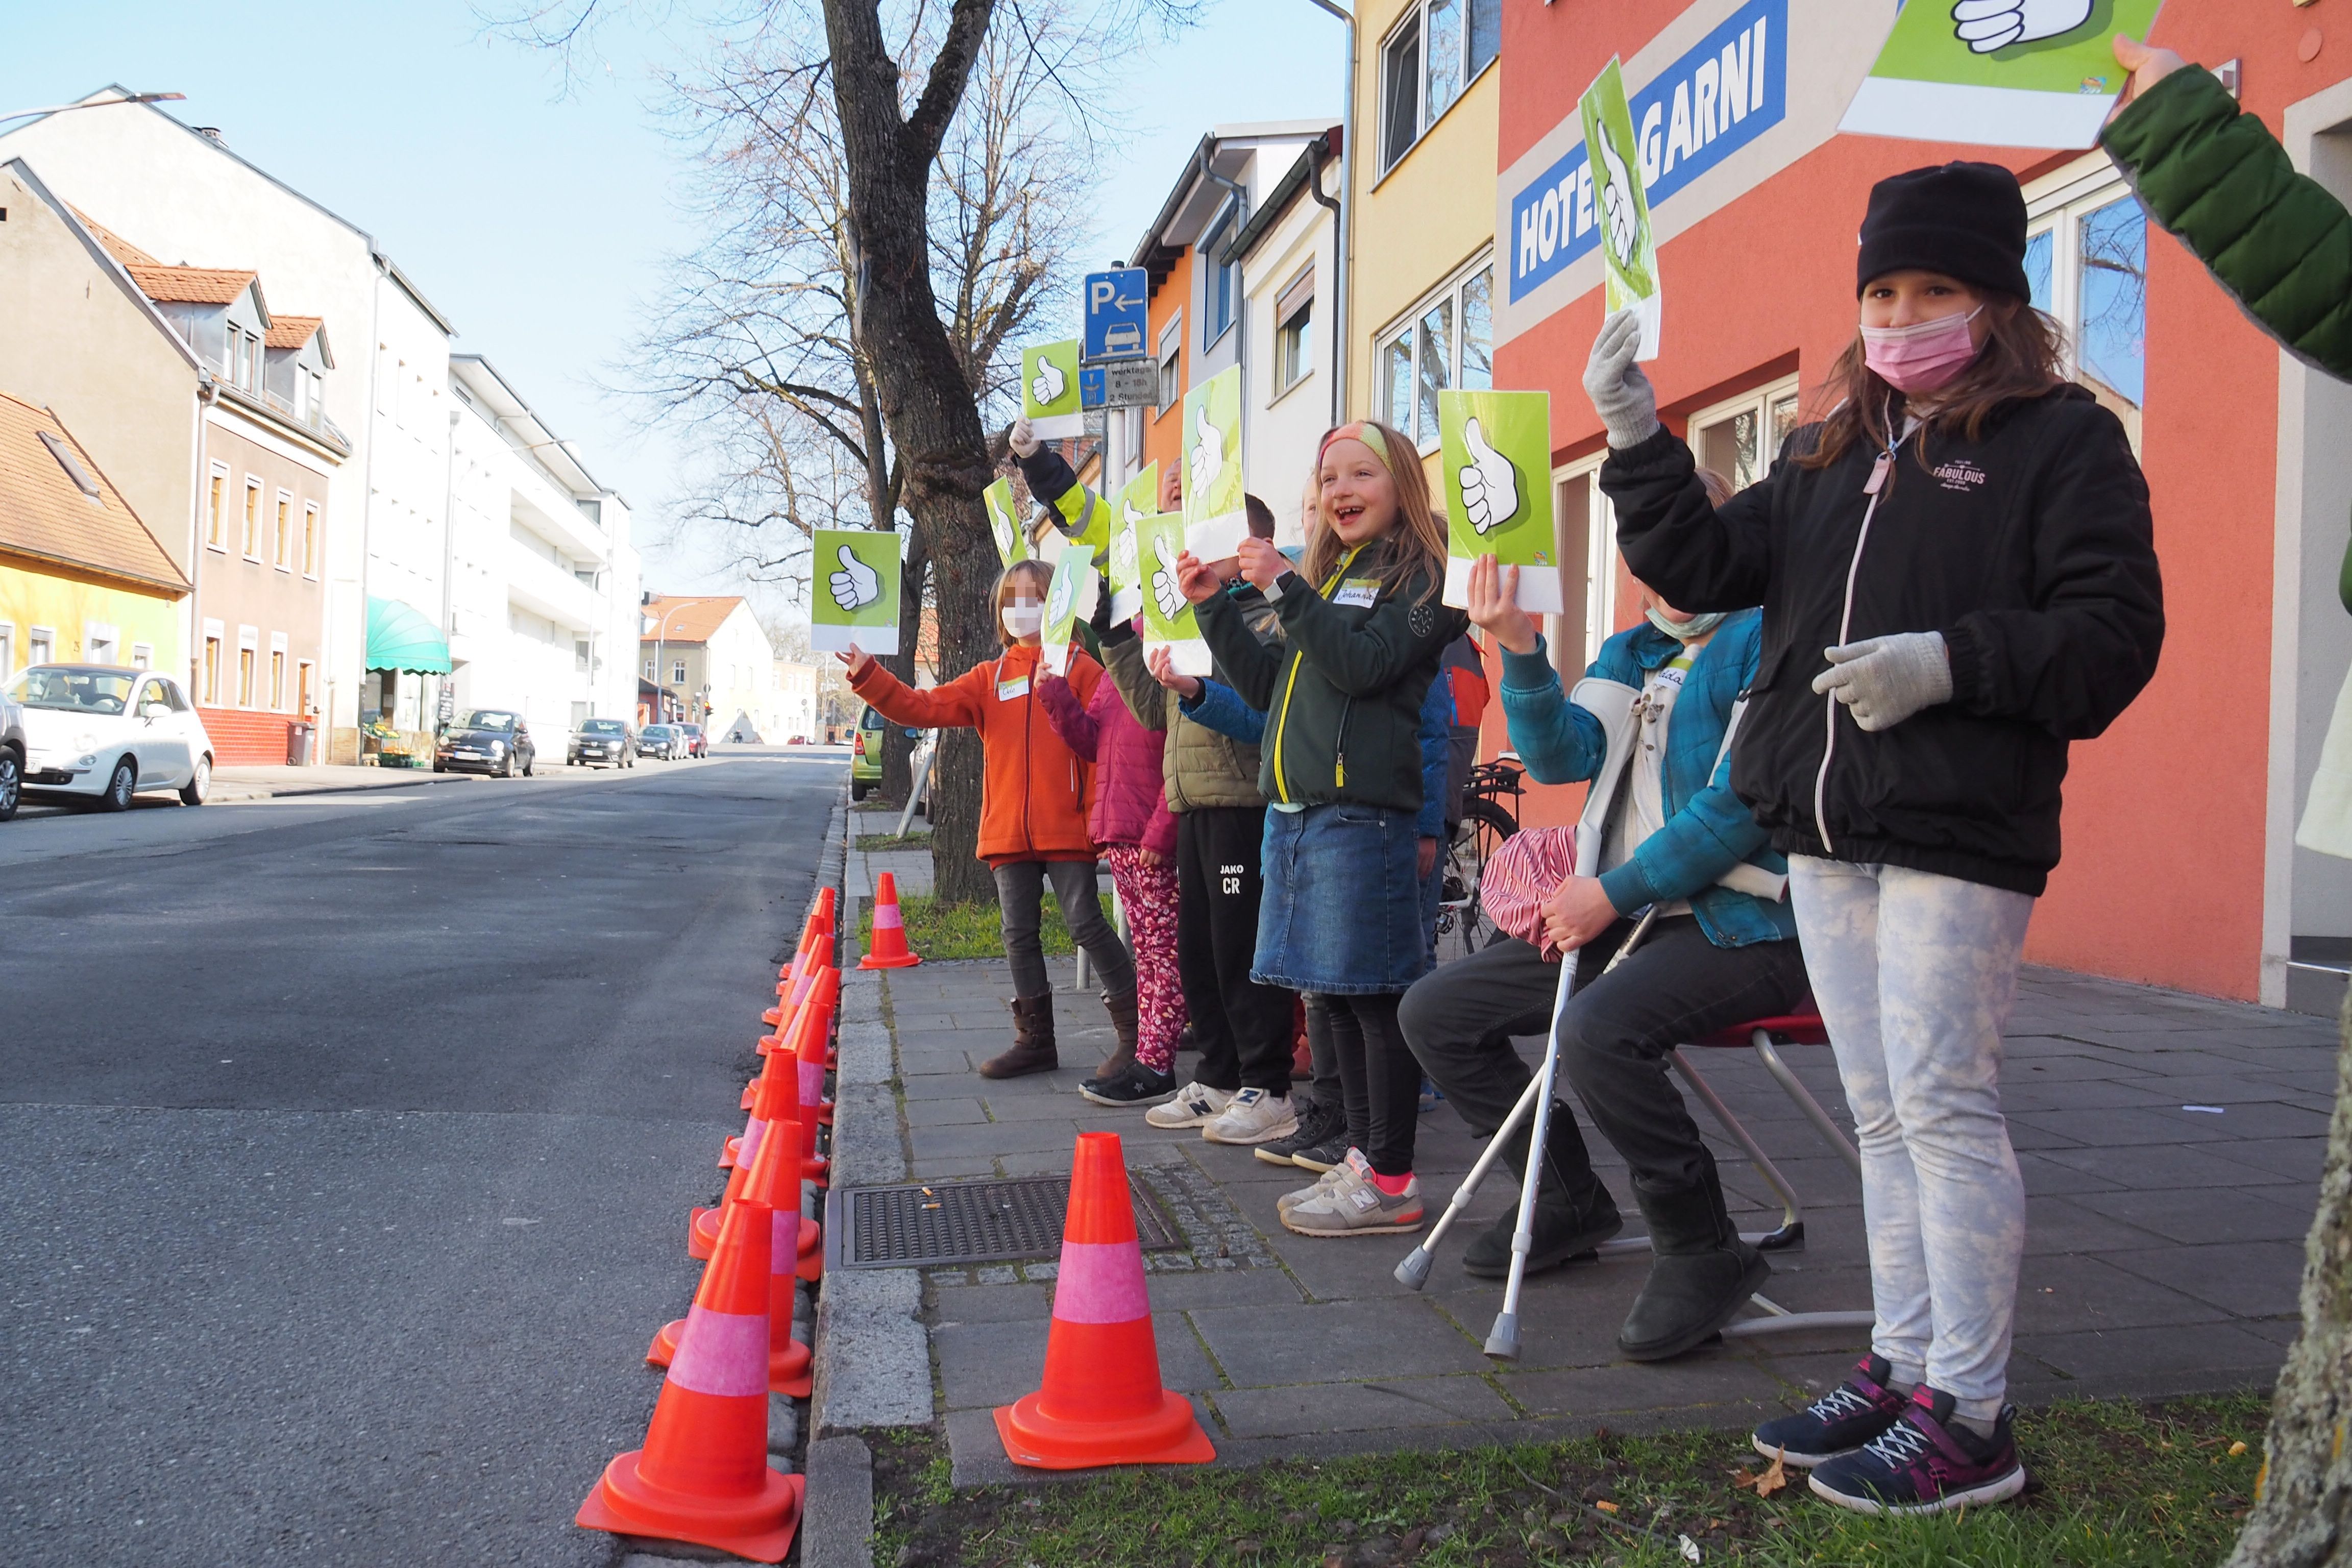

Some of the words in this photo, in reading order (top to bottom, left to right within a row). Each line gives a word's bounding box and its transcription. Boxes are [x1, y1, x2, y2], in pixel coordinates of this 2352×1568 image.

[1638, 15, 1766, 189] GARNI
[1091, 282, 1115, 315] P
[1933, 467, 1986, 484] FABULOUS
[1220, 864, 1244, 874] JAKO
[1222, 877, 1240, 894] CR
